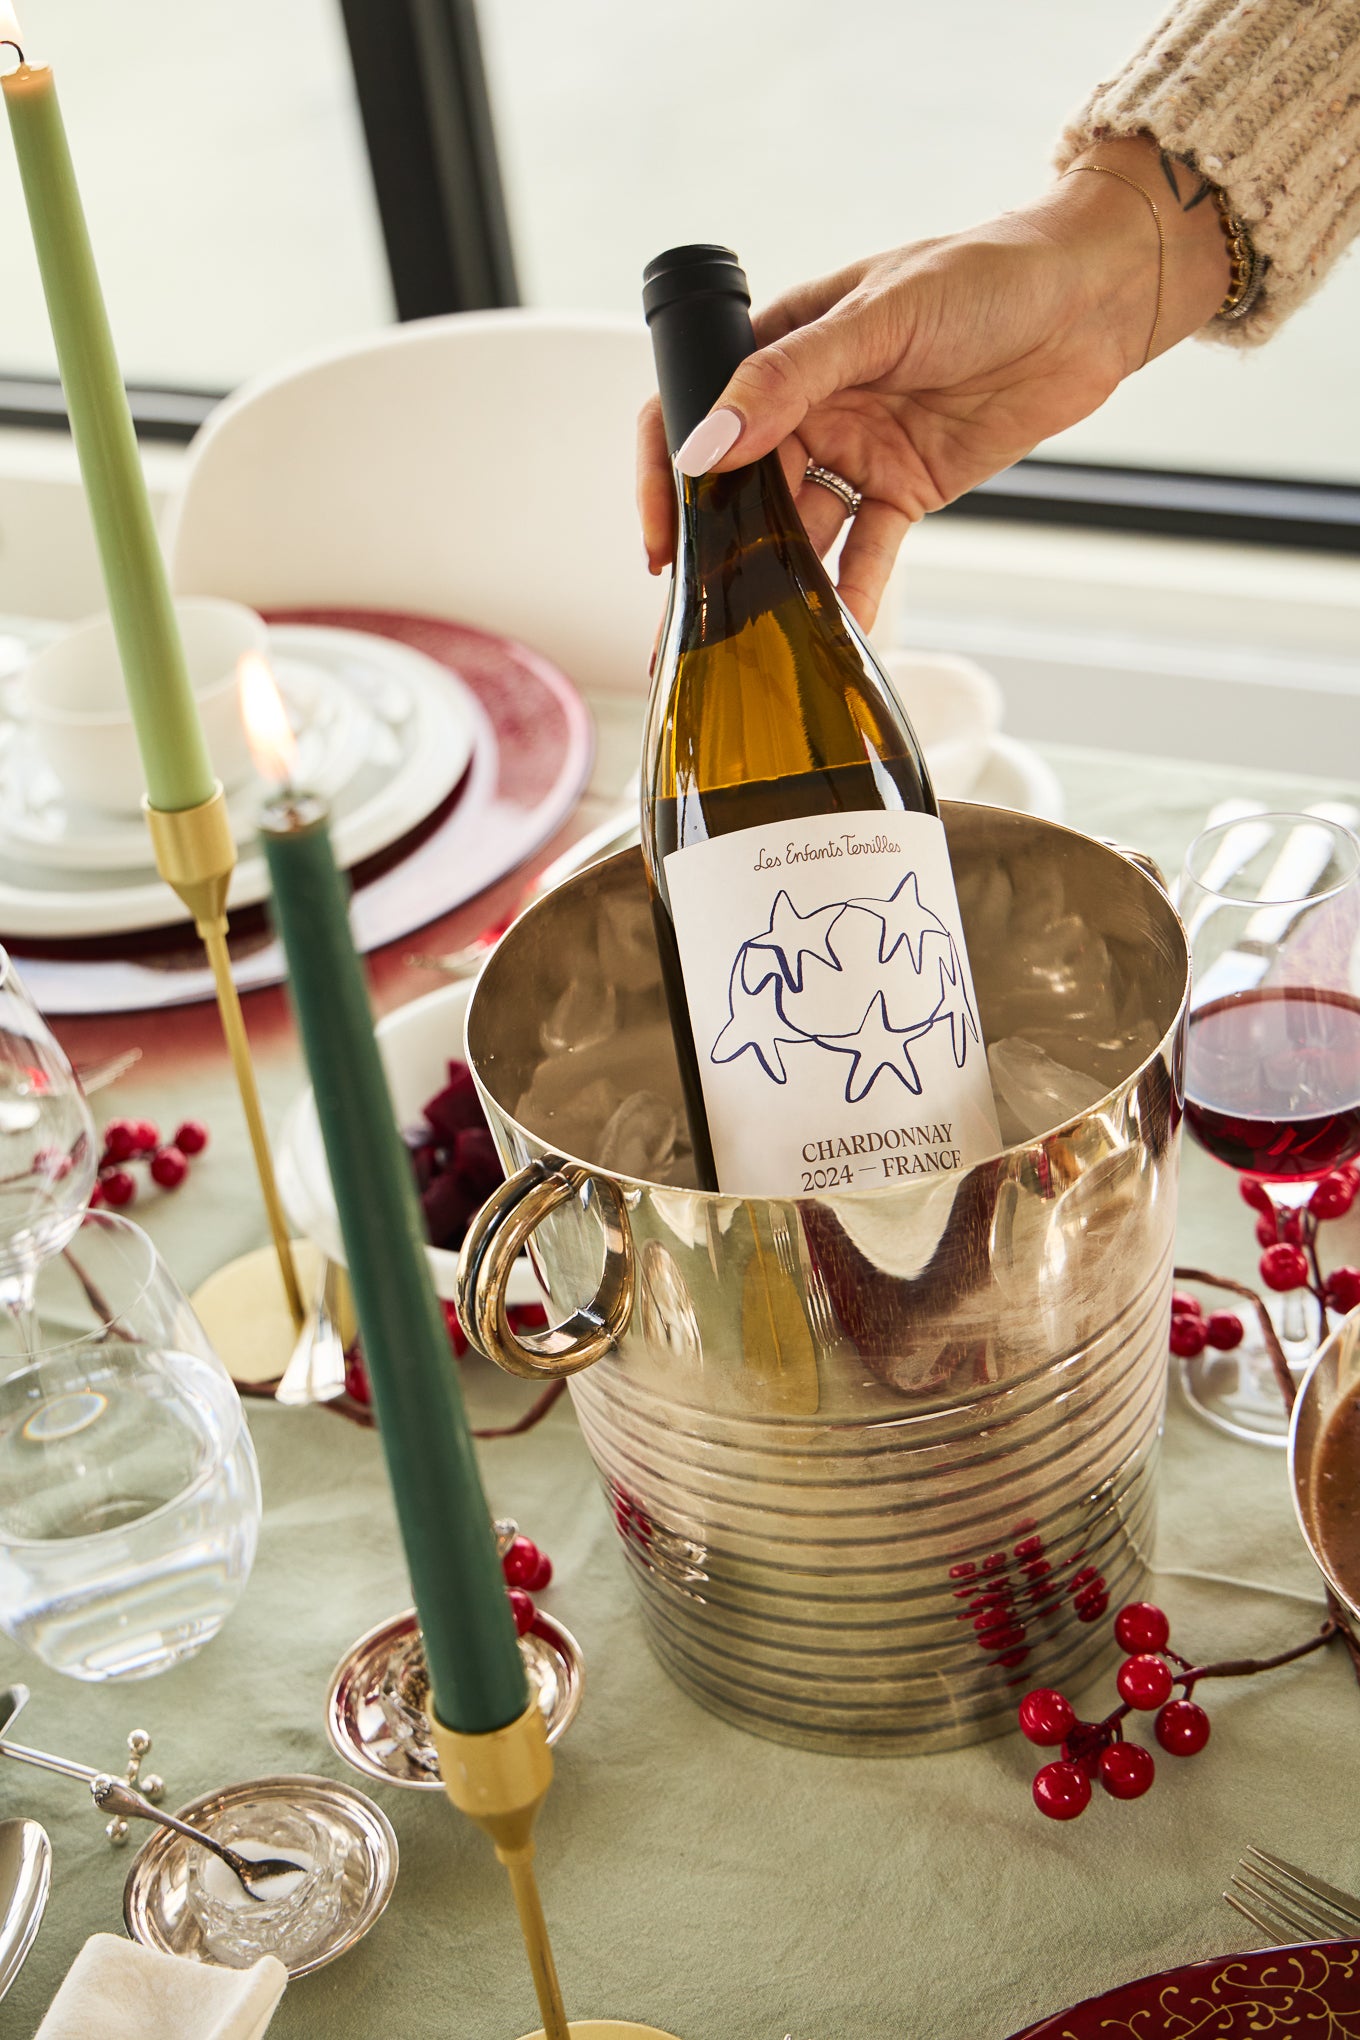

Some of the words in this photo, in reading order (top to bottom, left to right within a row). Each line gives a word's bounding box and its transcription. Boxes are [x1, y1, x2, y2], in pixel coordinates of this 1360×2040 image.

[753, 848, 782, 871] Les
[786, 841, 843, 865] Enfants
[802, 1123, 952, 1163] CHARDONNAY
[801, 1164, 854, 1192] 2024
[882, 1150, 963, 1178] FRANCE
